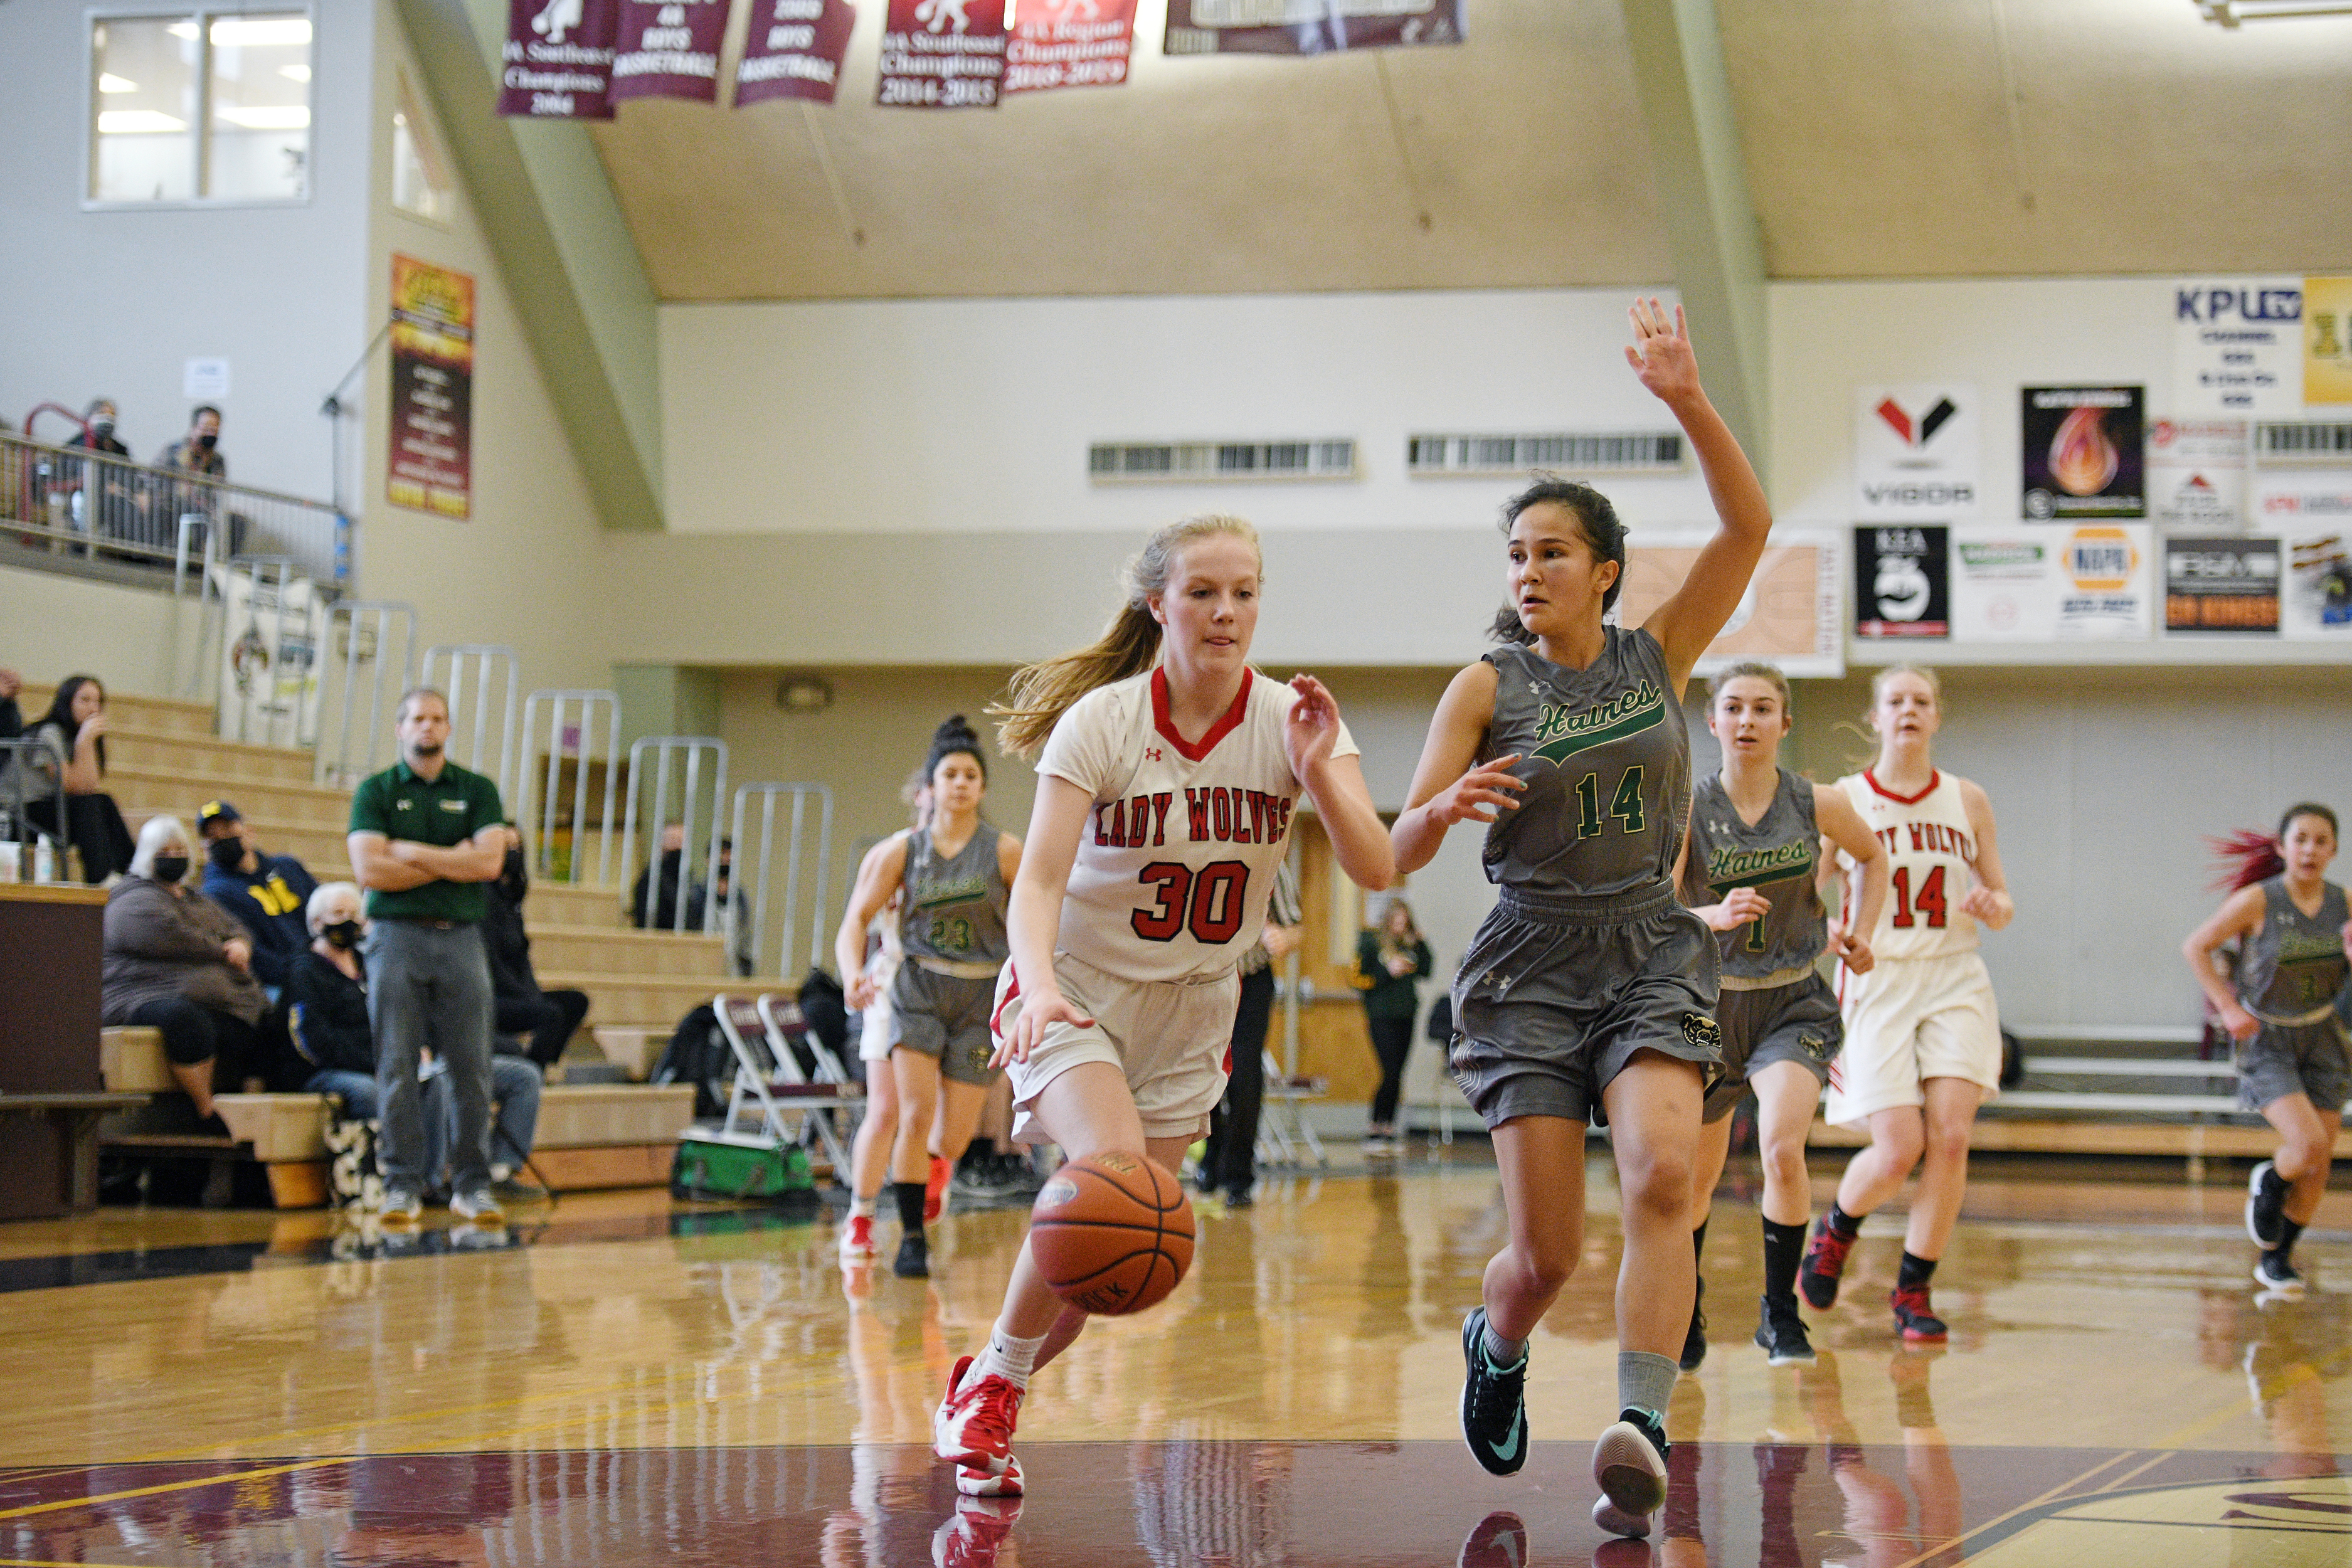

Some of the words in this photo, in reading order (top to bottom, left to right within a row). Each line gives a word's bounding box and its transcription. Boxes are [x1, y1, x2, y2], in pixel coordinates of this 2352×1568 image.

[881, 53, 1004, 77] Champions
[1007, 38, 1128, 63] Champions
[2176, 287, 2262, 321] KPU
[1863, 482, 1974, 506] VIGOR
[1534, 679, 1663, 742] Haines
[1094, 792, 1173, 848] LADY
[1185, 787, 1291, 845] WOLVES
[1576, 765, 1646, 840] 14
[1709, 839, 1813, 878] Haines
[1130, 860, 1251, 945] 30
[1893, 865, 1948, 930] 14
[930, 919, 970, 950] 23
